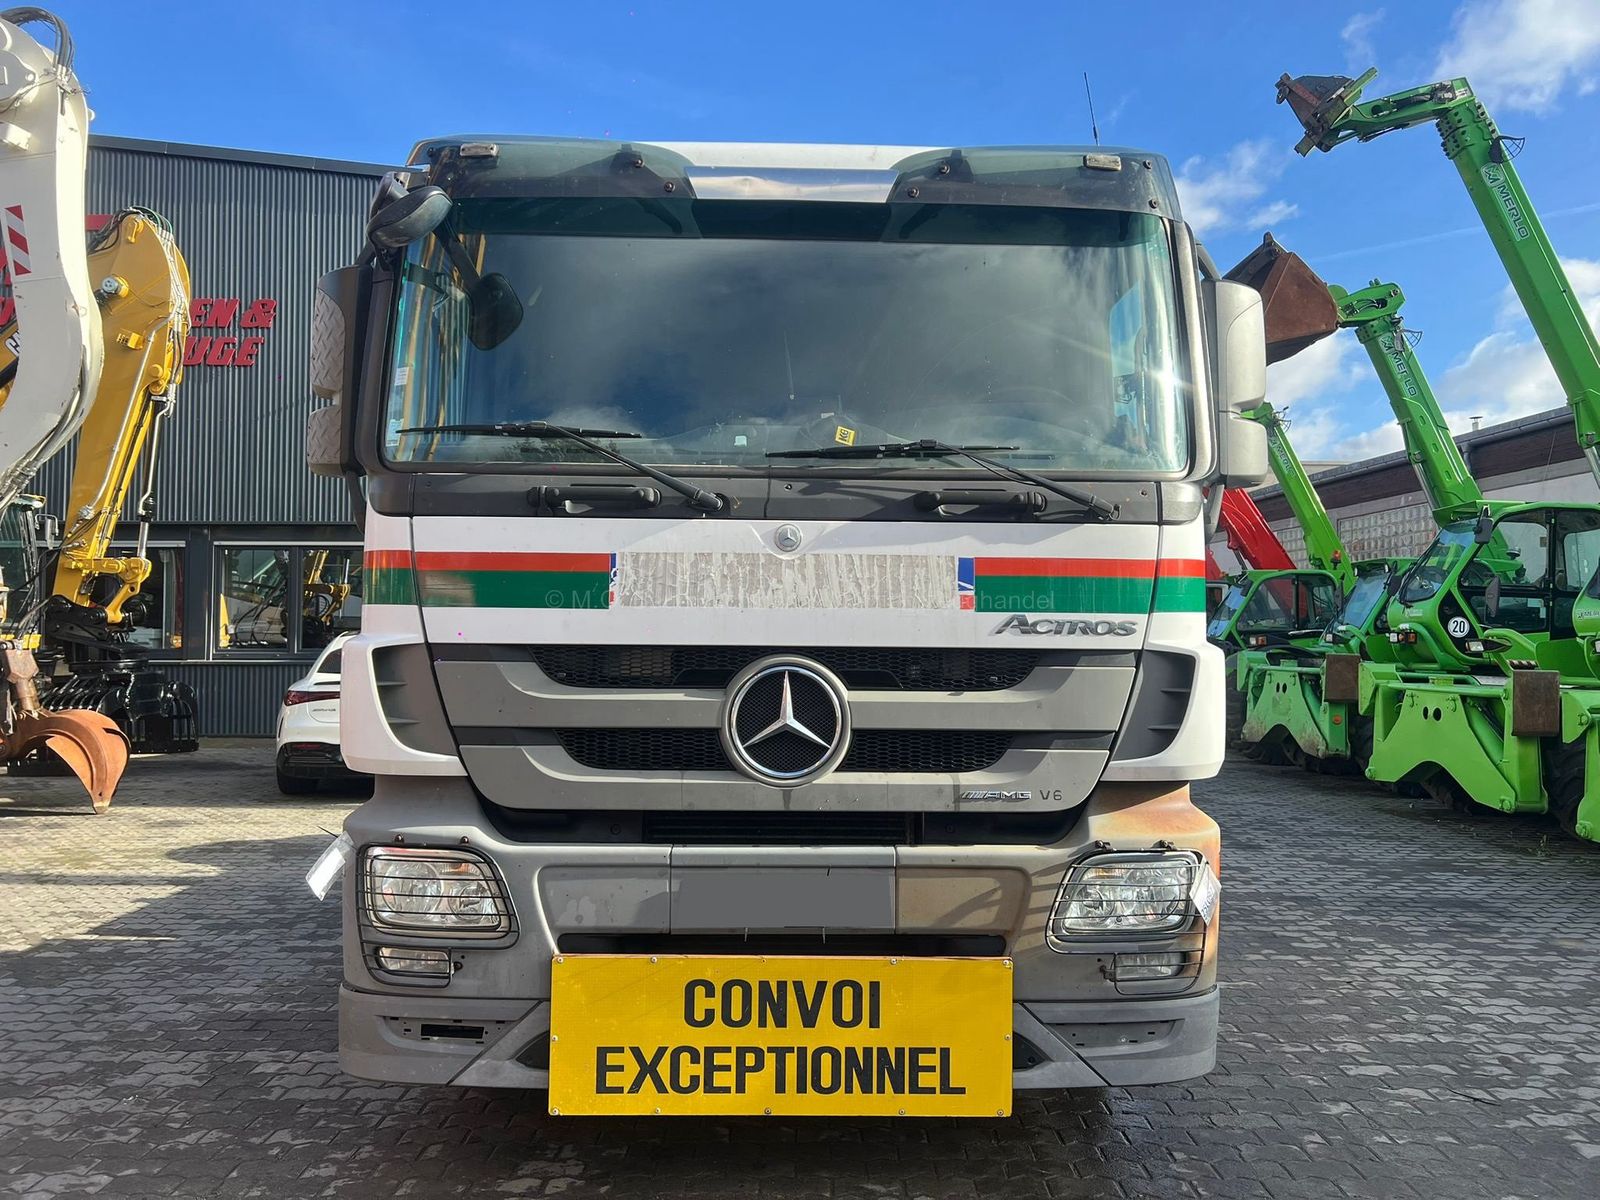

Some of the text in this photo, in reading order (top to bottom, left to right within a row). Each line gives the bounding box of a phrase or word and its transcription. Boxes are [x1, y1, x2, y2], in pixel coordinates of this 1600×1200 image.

[1498, 184, 1529, 238] MERLO
[240, 298, 277, 328] &
[1452, 620, 1466, 633] 20
[1039, 790, 1063, 801] V6
[683, 979, 881, 1029] CONVOI
[595, 1045, 966, 1095] EXCEPTIONNEL
